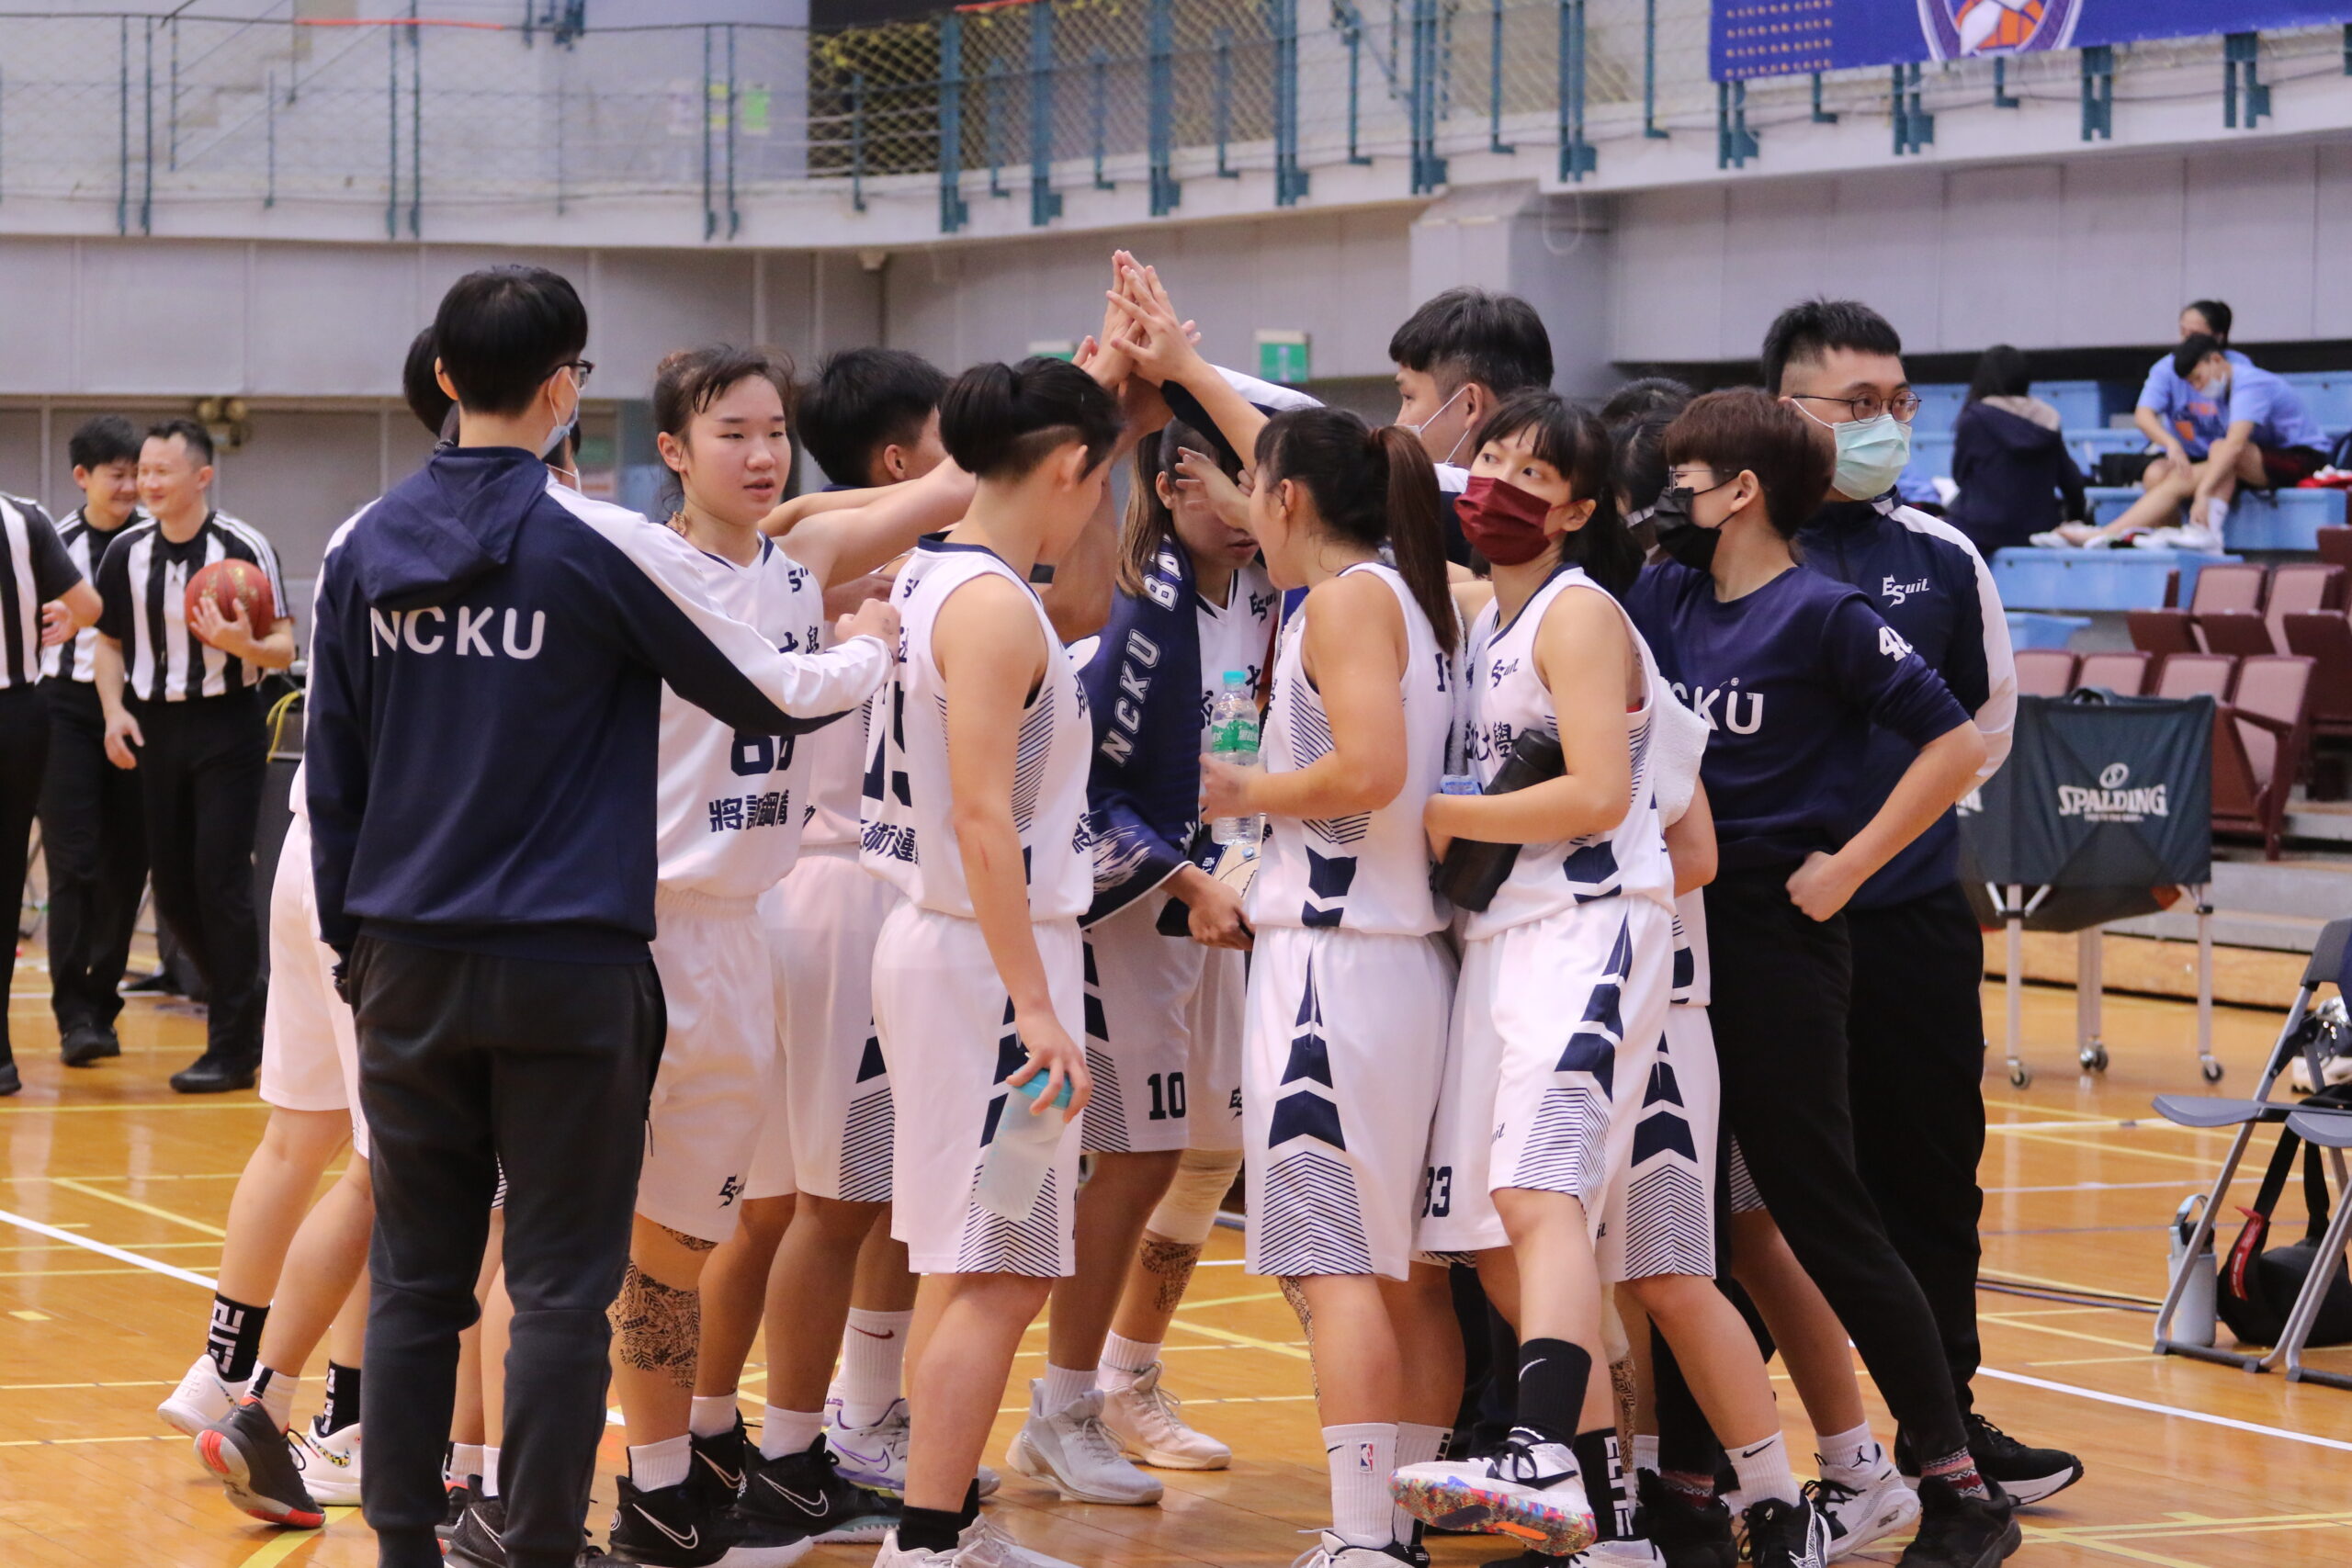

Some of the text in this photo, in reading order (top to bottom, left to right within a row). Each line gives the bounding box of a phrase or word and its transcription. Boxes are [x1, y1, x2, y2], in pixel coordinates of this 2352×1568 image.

[370, 605, 547, 660] NCKU
[1102, 628, 1160, 768] NCKU
[2057, 784, 2169, 817] SPALDING
[1147, 1071, 1187, 1121] 10
